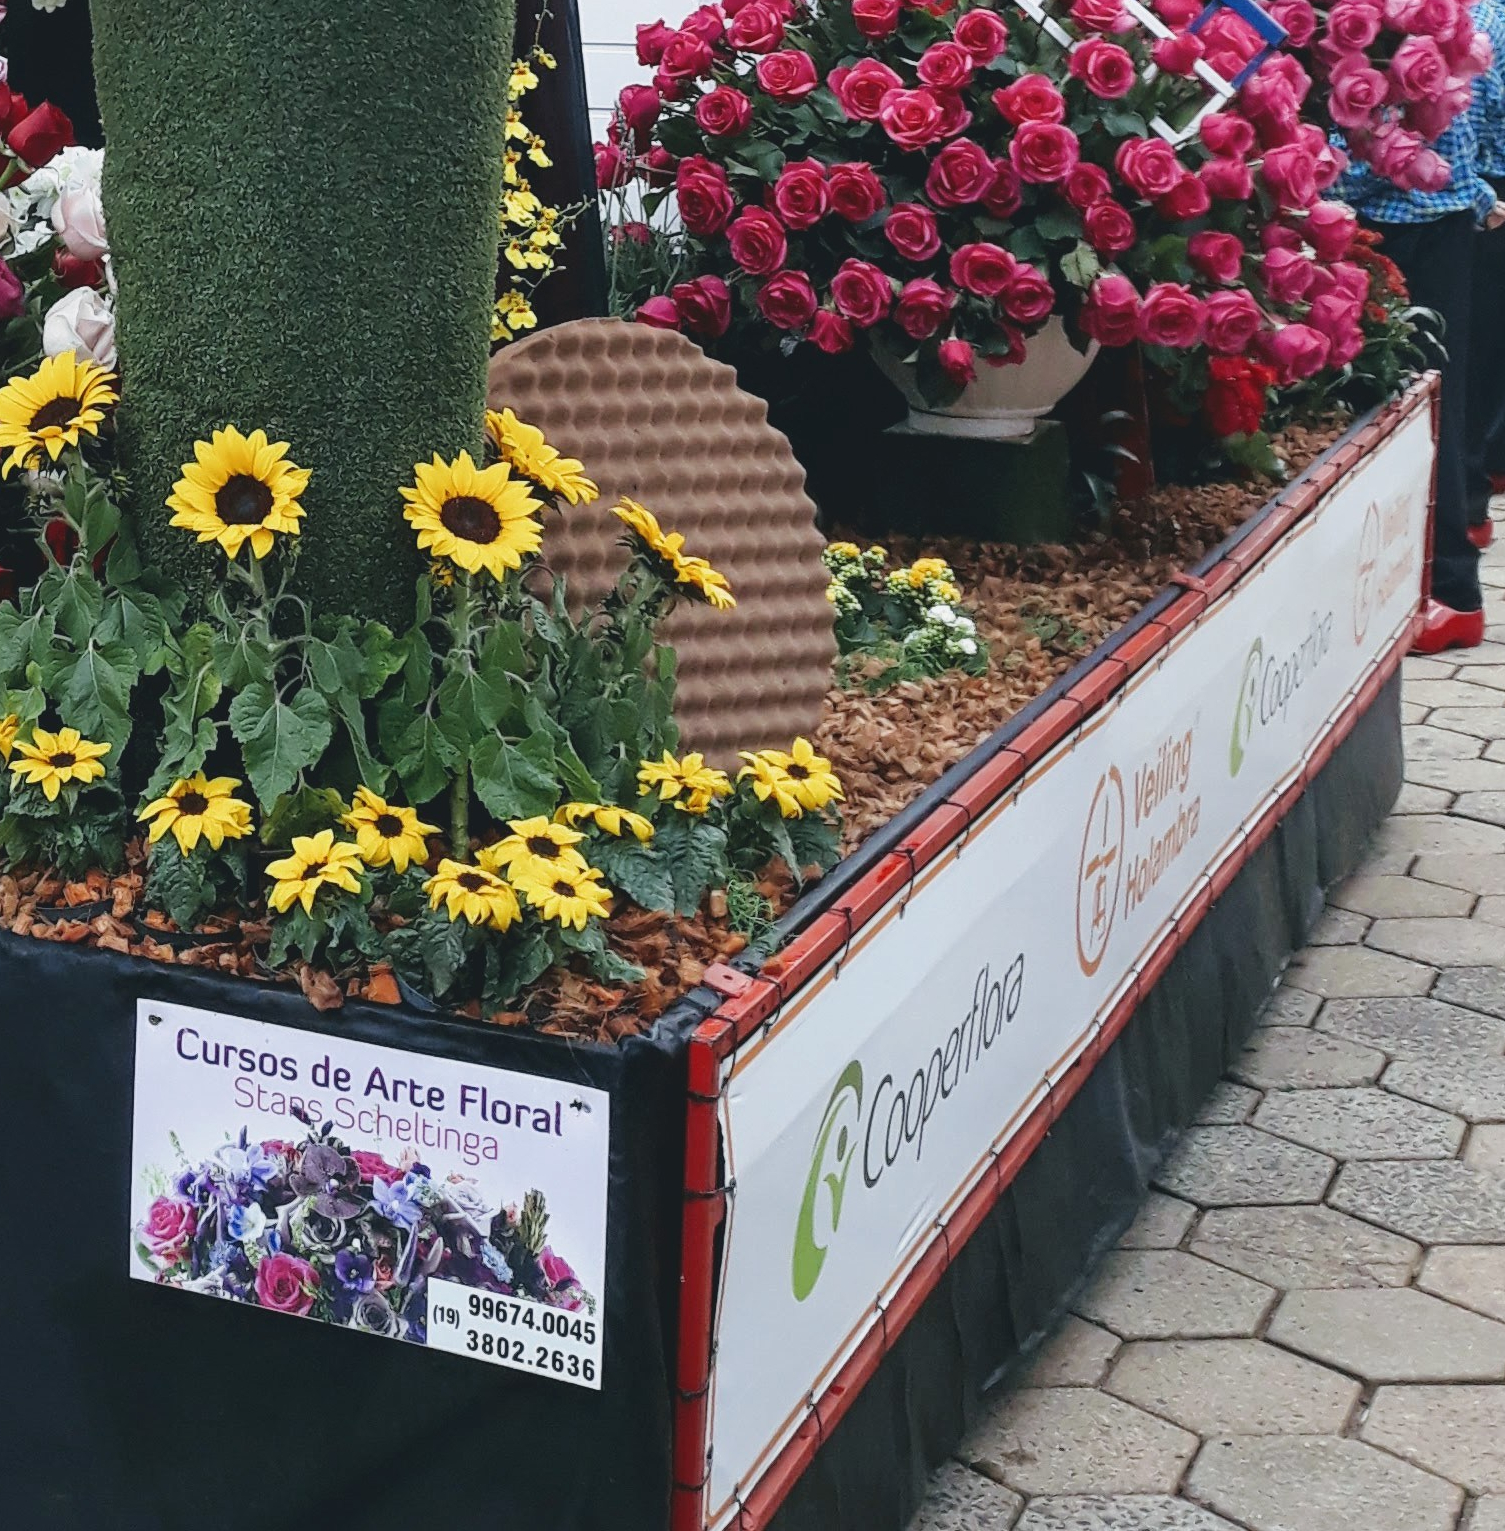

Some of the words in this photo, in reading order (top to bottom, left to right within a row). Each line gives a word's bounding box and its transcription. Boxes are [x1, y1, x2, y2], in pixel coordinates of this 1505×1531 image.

[1133, 727, 1193, 829] Veiling
[1124, 795, 1201, 921] Holambra
[175, 1027, 298, 1080] Cursos
[310, 1054, 351, 1093] de
[363, 1066, 445, 1112] Arte
[459, 1084, 564, 1137] Floral
[862, 951, 1026, 1189] Cooperflora
[335, 1097, 499, 1166] Scheltinga
[432, 1291, 461, 1331] (19)
[468, 1294, 597, 1346] 99674.0045
[465, 1329, 596, 1383] 3802.2636
